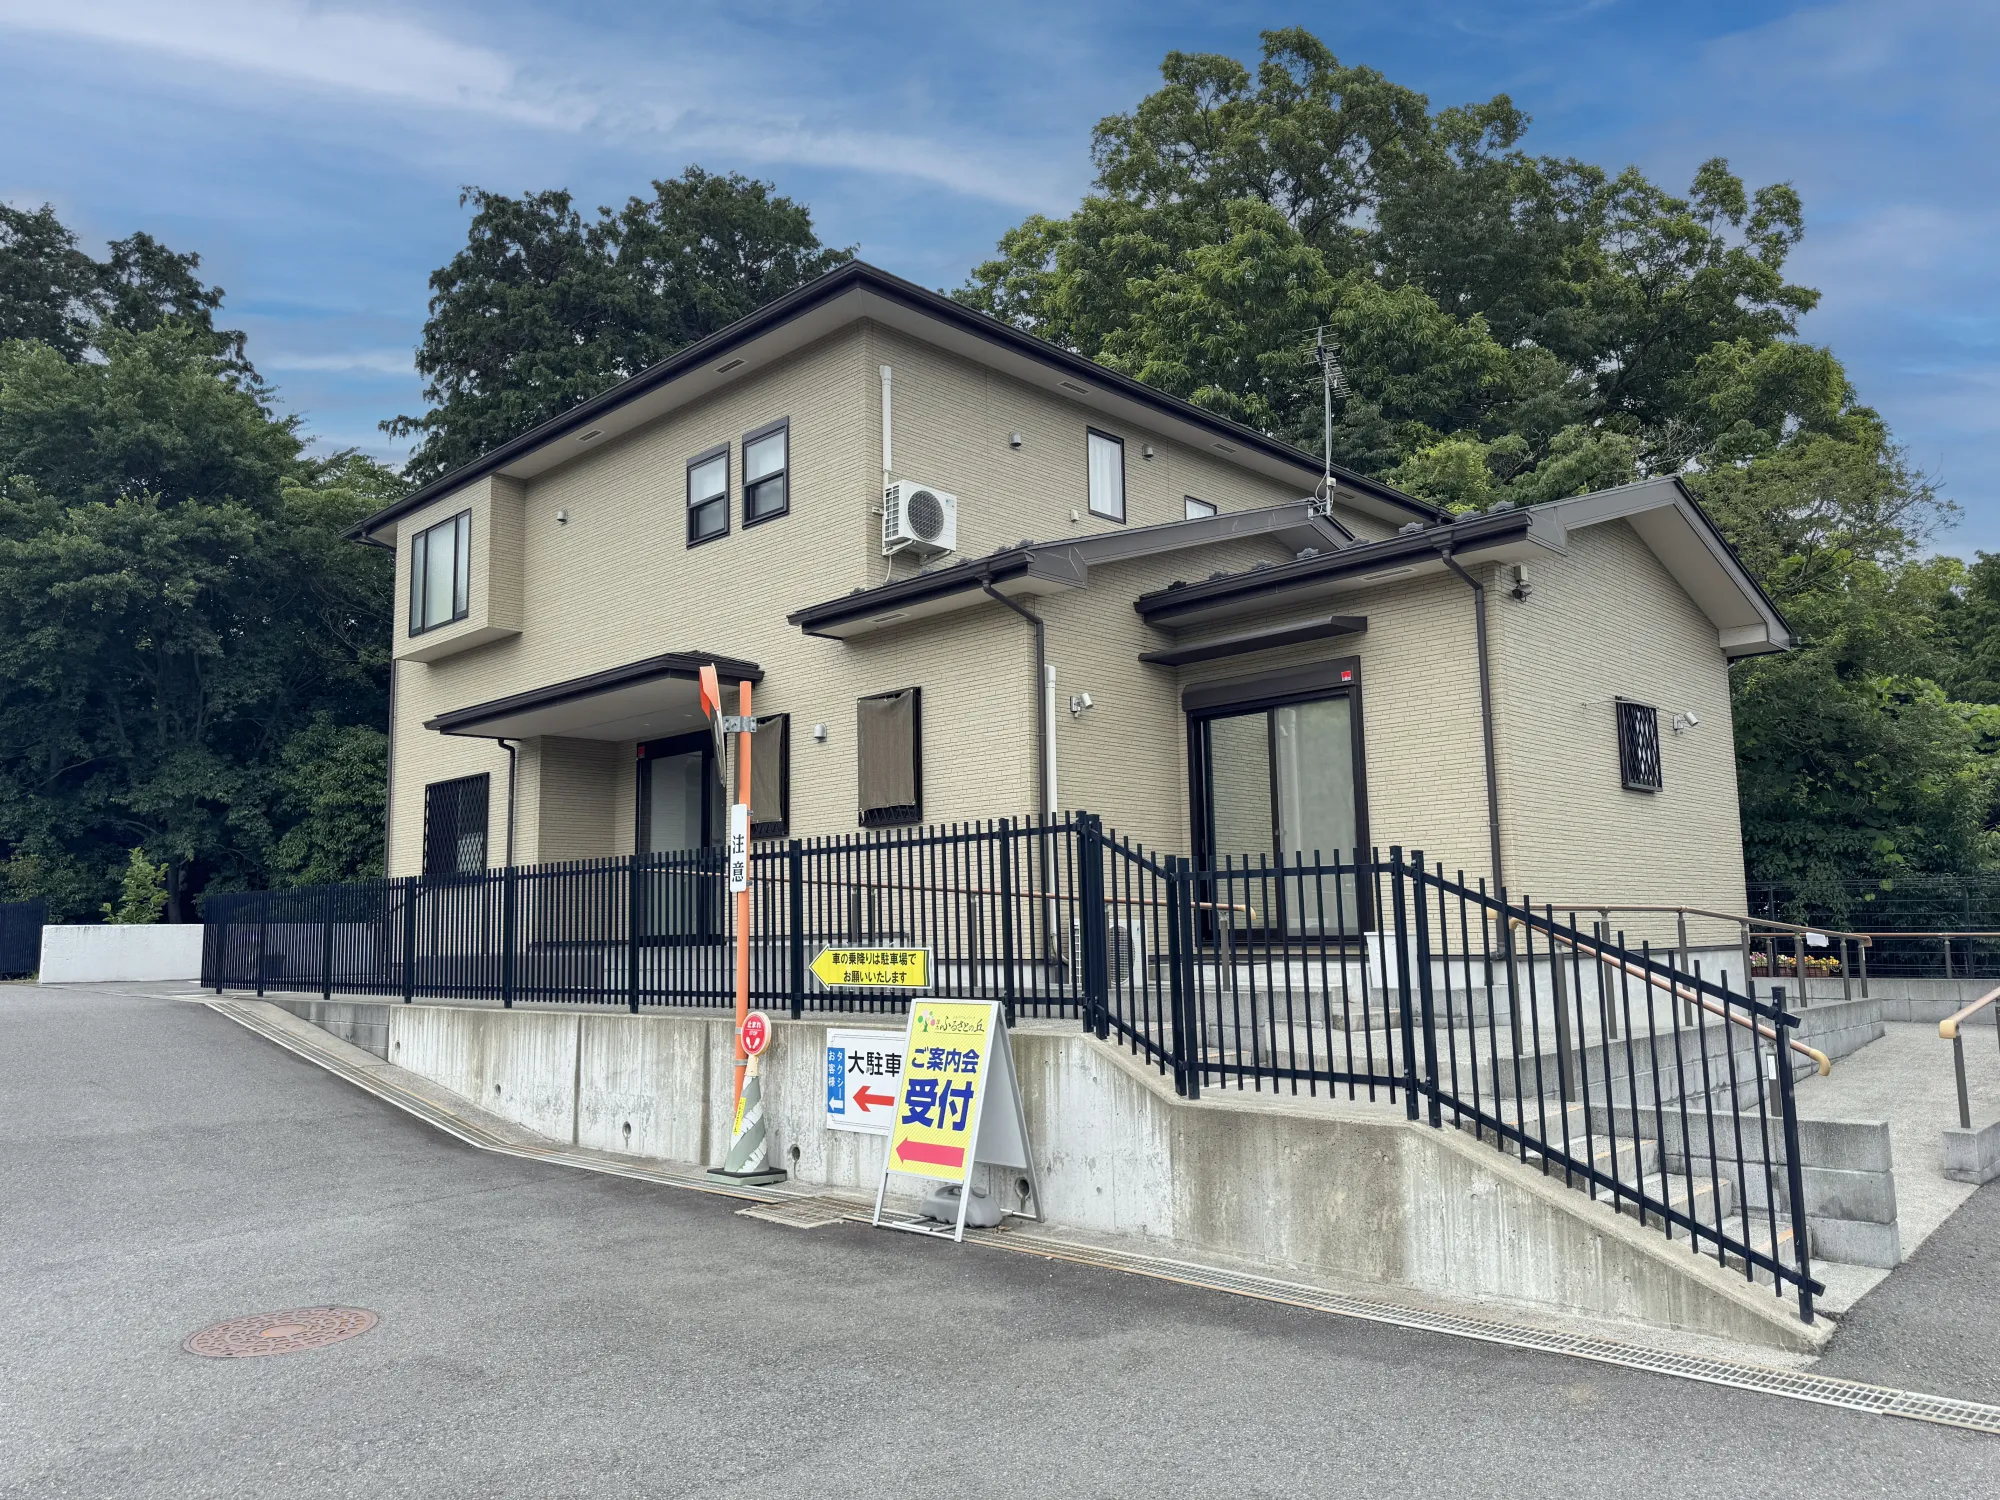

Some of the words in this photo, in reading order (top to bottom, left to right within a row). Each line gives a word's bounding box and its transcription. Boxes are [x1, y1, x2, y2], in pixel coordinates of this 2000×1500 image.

[732, 834, 744, 882] 注意
[832, 952, 916, 966] 車の乗降りは駐車場で
[843, 970, 907, 984] お願いいたします
[828, 1050, 836, 1087] お客様
[911, 1046, 980, 1074] ご案内会
[901, 1078, 974, 1131] 受付
